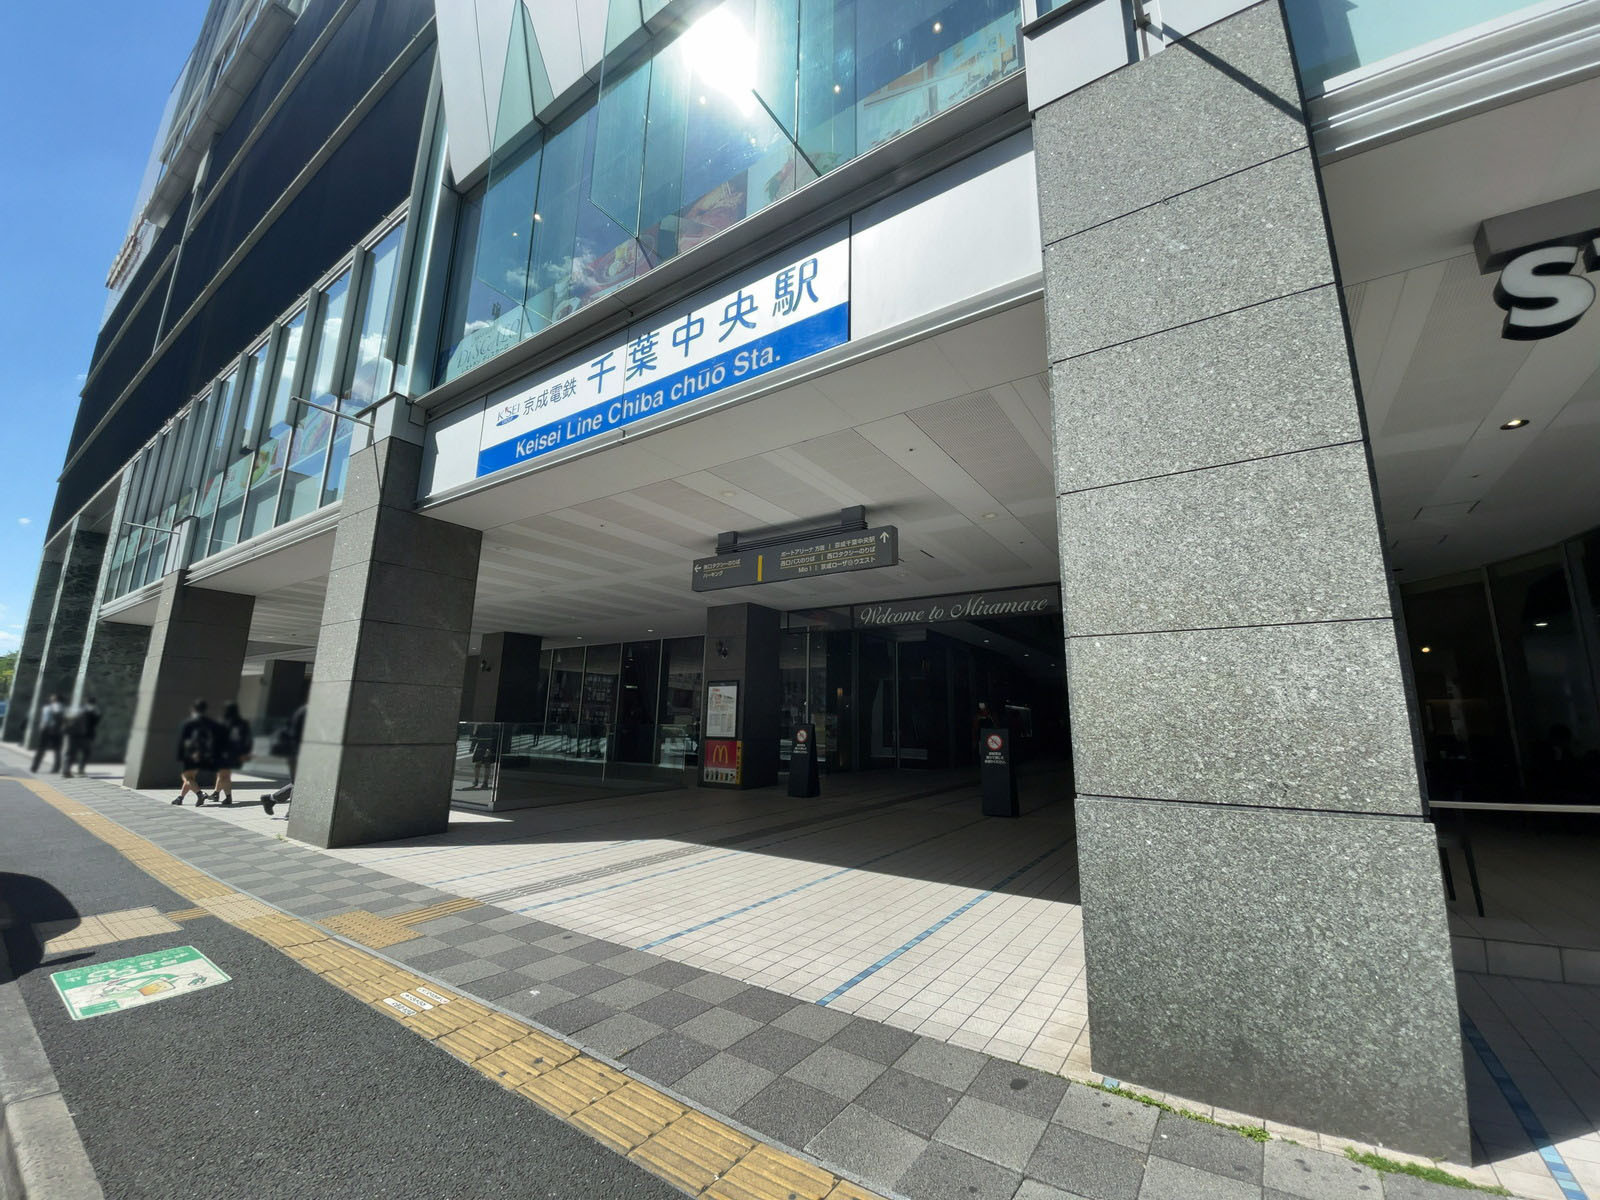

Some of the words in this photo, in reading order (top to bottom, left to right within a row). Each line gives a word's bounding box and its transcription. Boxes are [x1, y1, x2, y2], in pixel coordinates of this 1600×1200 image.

[1497, 236, 1600, 332] S
[522, 377, 577, 416] 京成電鉄
[586, 257, 820, 394] 千葉中央駅
[514, 425, 562, 459] Keisei
[566, 413, 603, 440] Line
[608, 389, 664, 424] Chiba
[670, 361, 726, 401] chūō
[733, 346, 781, 377] Sta.
[860, 606, 926, 625] Welcome
[928, 605, 945, 623] to
[950, 595, 1048, 618] Miramare
